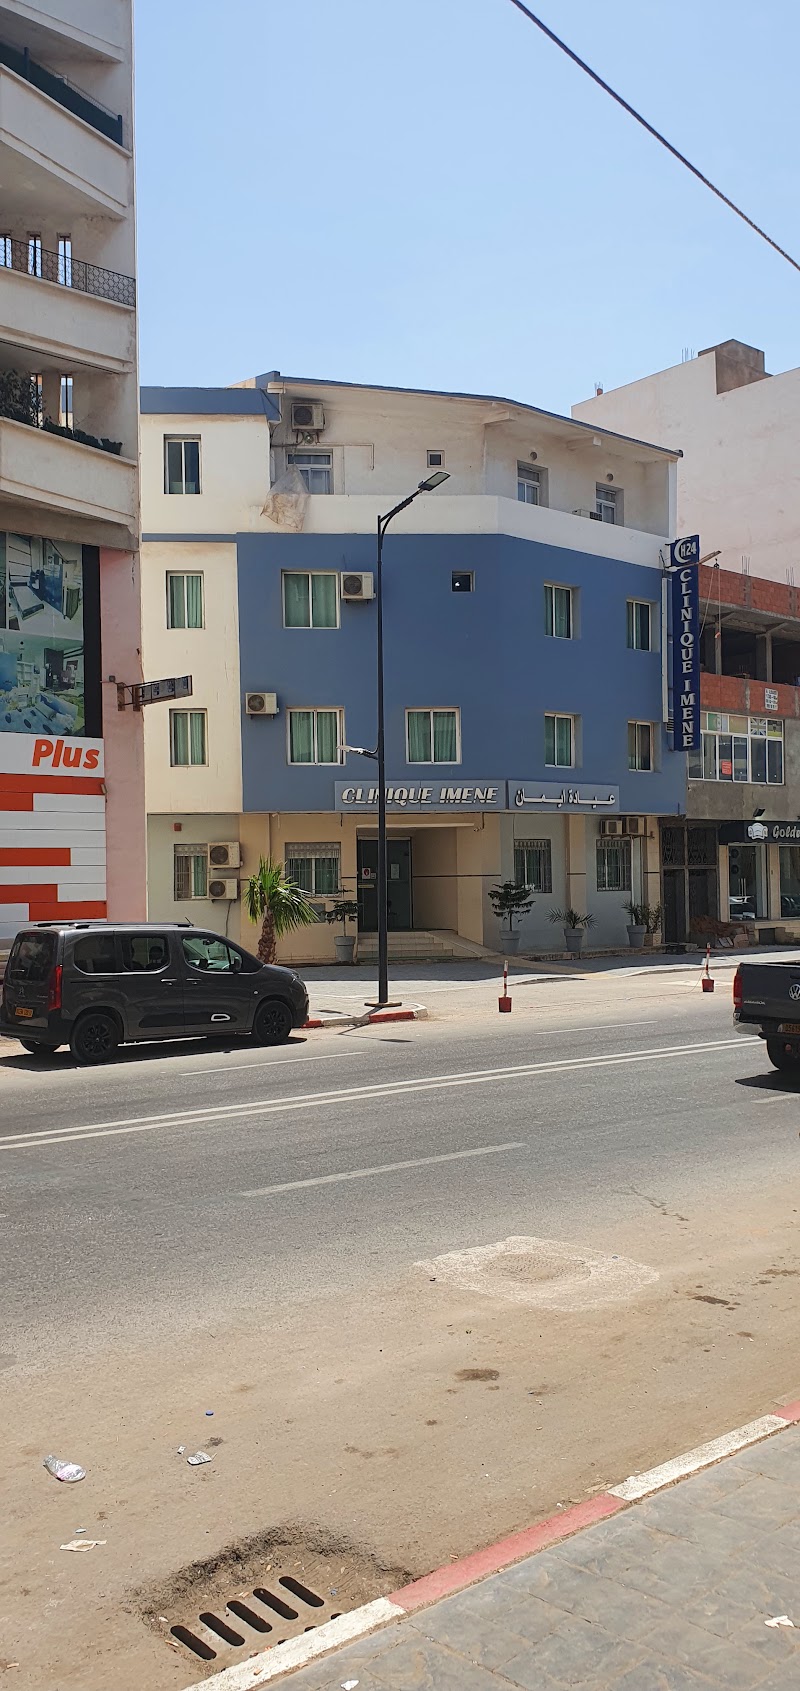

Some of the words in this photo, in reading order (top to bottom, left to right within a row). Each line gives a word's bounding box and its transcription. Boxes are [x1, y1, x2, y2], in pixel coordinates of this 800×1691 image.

[679, 569, 695, 674] CLINIQUE
[680, 680, 696, 747] IMENE
[32, 739, 100, 769] Plus
[440, 787, 499, 804] IMENE
[568, 788, 616, 809] عيادة
